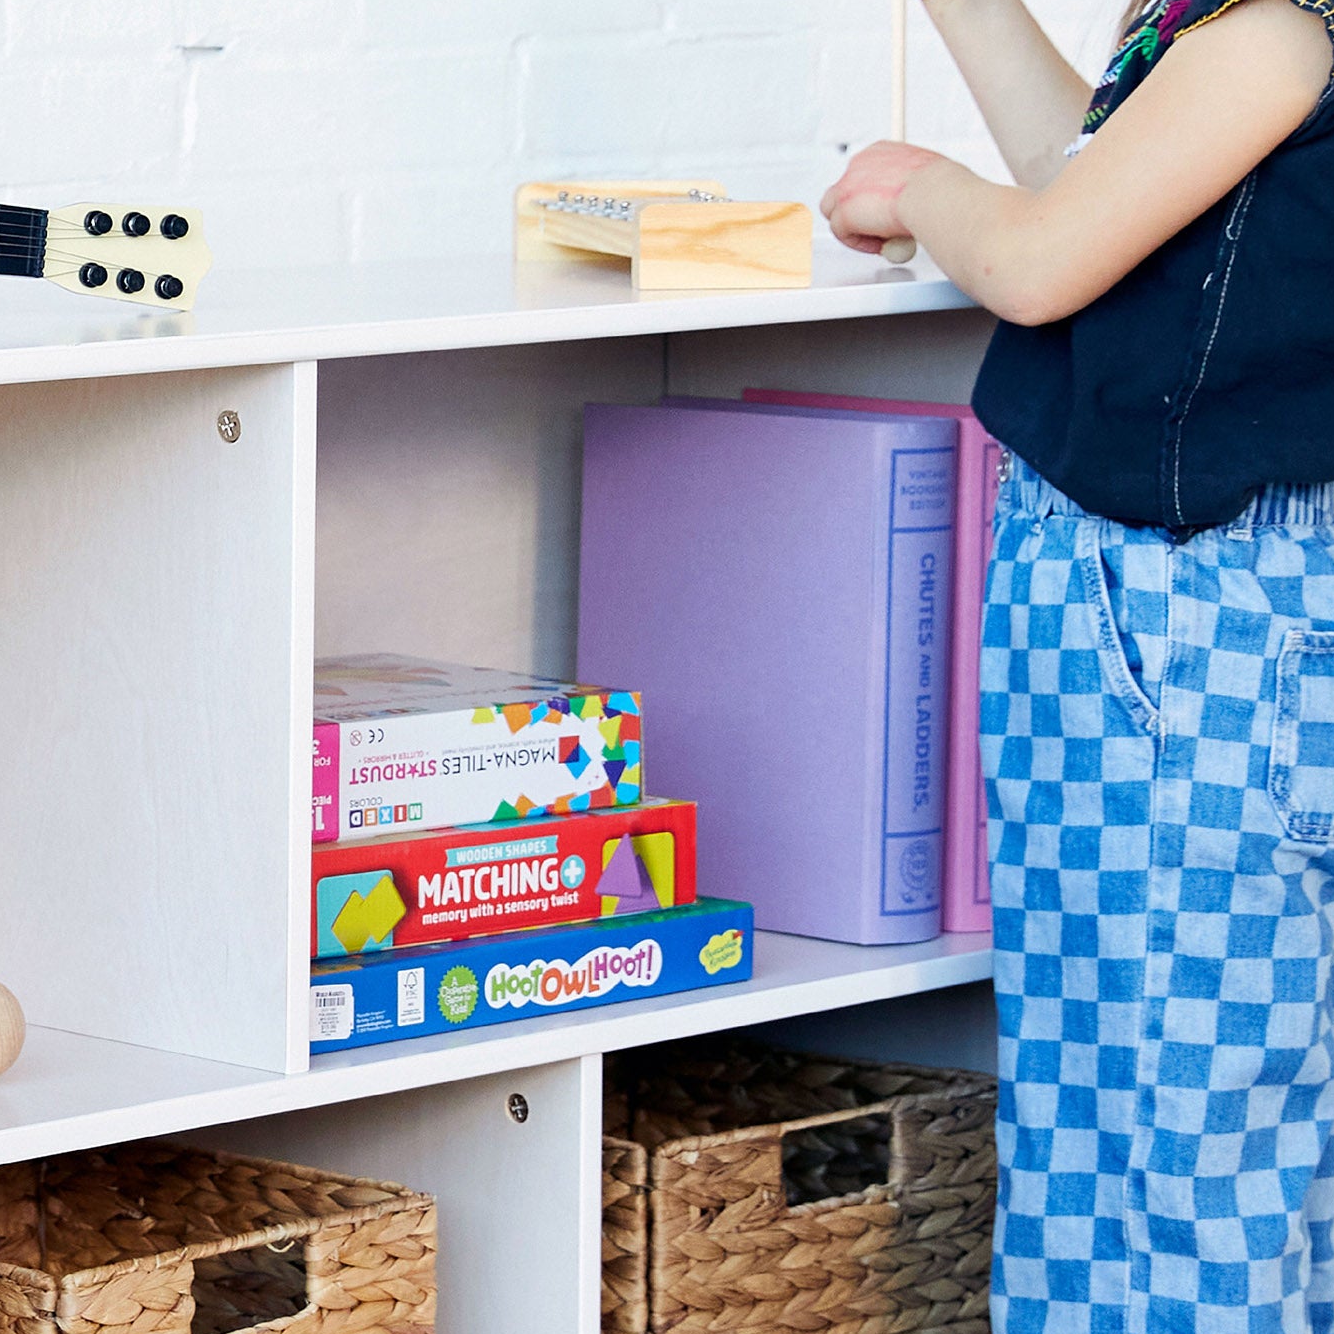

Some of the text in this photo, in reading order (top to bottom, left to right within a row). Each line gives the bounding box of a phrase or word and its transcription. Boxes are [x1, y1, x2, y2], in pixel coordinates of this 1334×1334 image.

[918, 552, 935, 647] CHUTES
[919, 654, 931, 688] AND
[313, 756, 331, 767] FOR
[442, 746, 556, 775] MAGNA-TILES
[313, 794, 332, 807] PIEC
[349, 796, 383, 808] COLORS
[313, 806, 326, 831] 1
[349, 803, 422, 828] MIXED
[456, 840, 547, 864] WOODEN SHAPES
[422, 891, 579, 925] memory with a sensory twist
